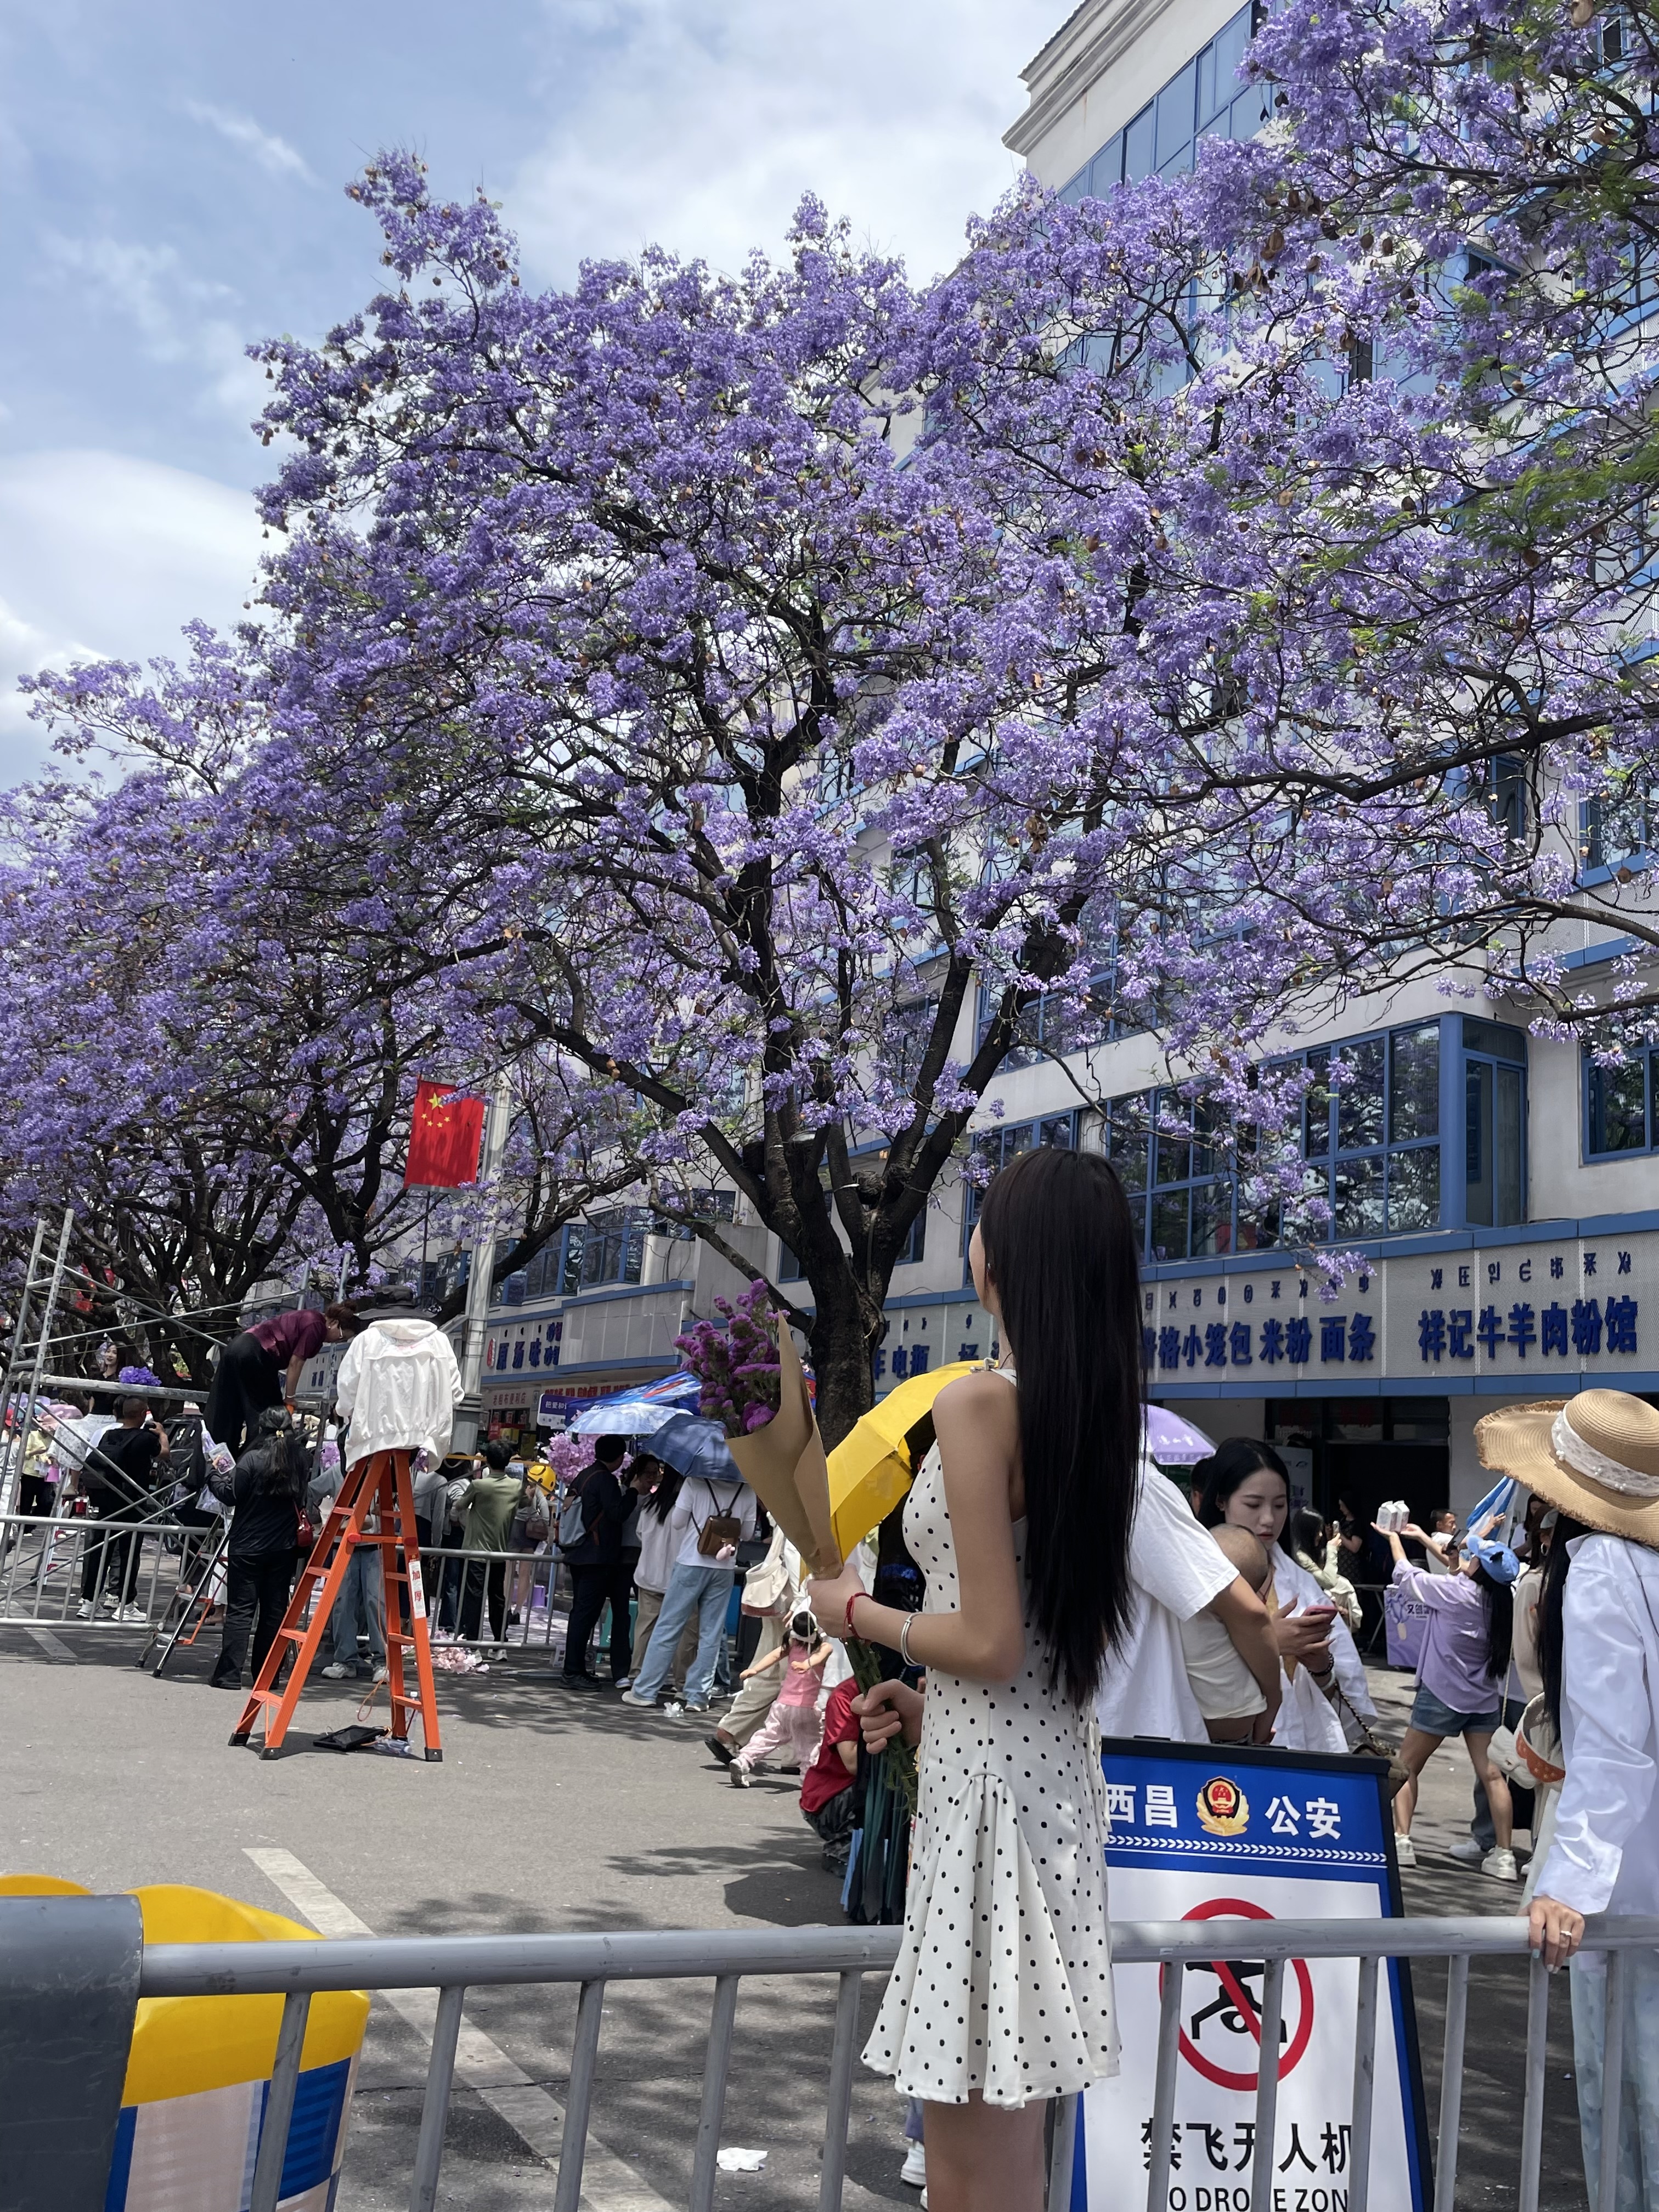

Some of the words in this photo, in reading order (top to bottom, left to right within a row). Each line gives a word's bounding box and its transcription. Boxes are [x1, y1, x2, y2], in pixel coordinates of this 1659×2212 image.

[1418, 1295, 1638, 1362] 祥记牛羊肉粉馆
[545, 1401, 567, 1409] 把爱和
[1105, 1784, 1178, 1829] 西昌
[1265, 1795, 1341, 1839] 公安
[1196, 2187, 1286, 2212] DROE
[1295, 2188, 1348, 2212] ZON
